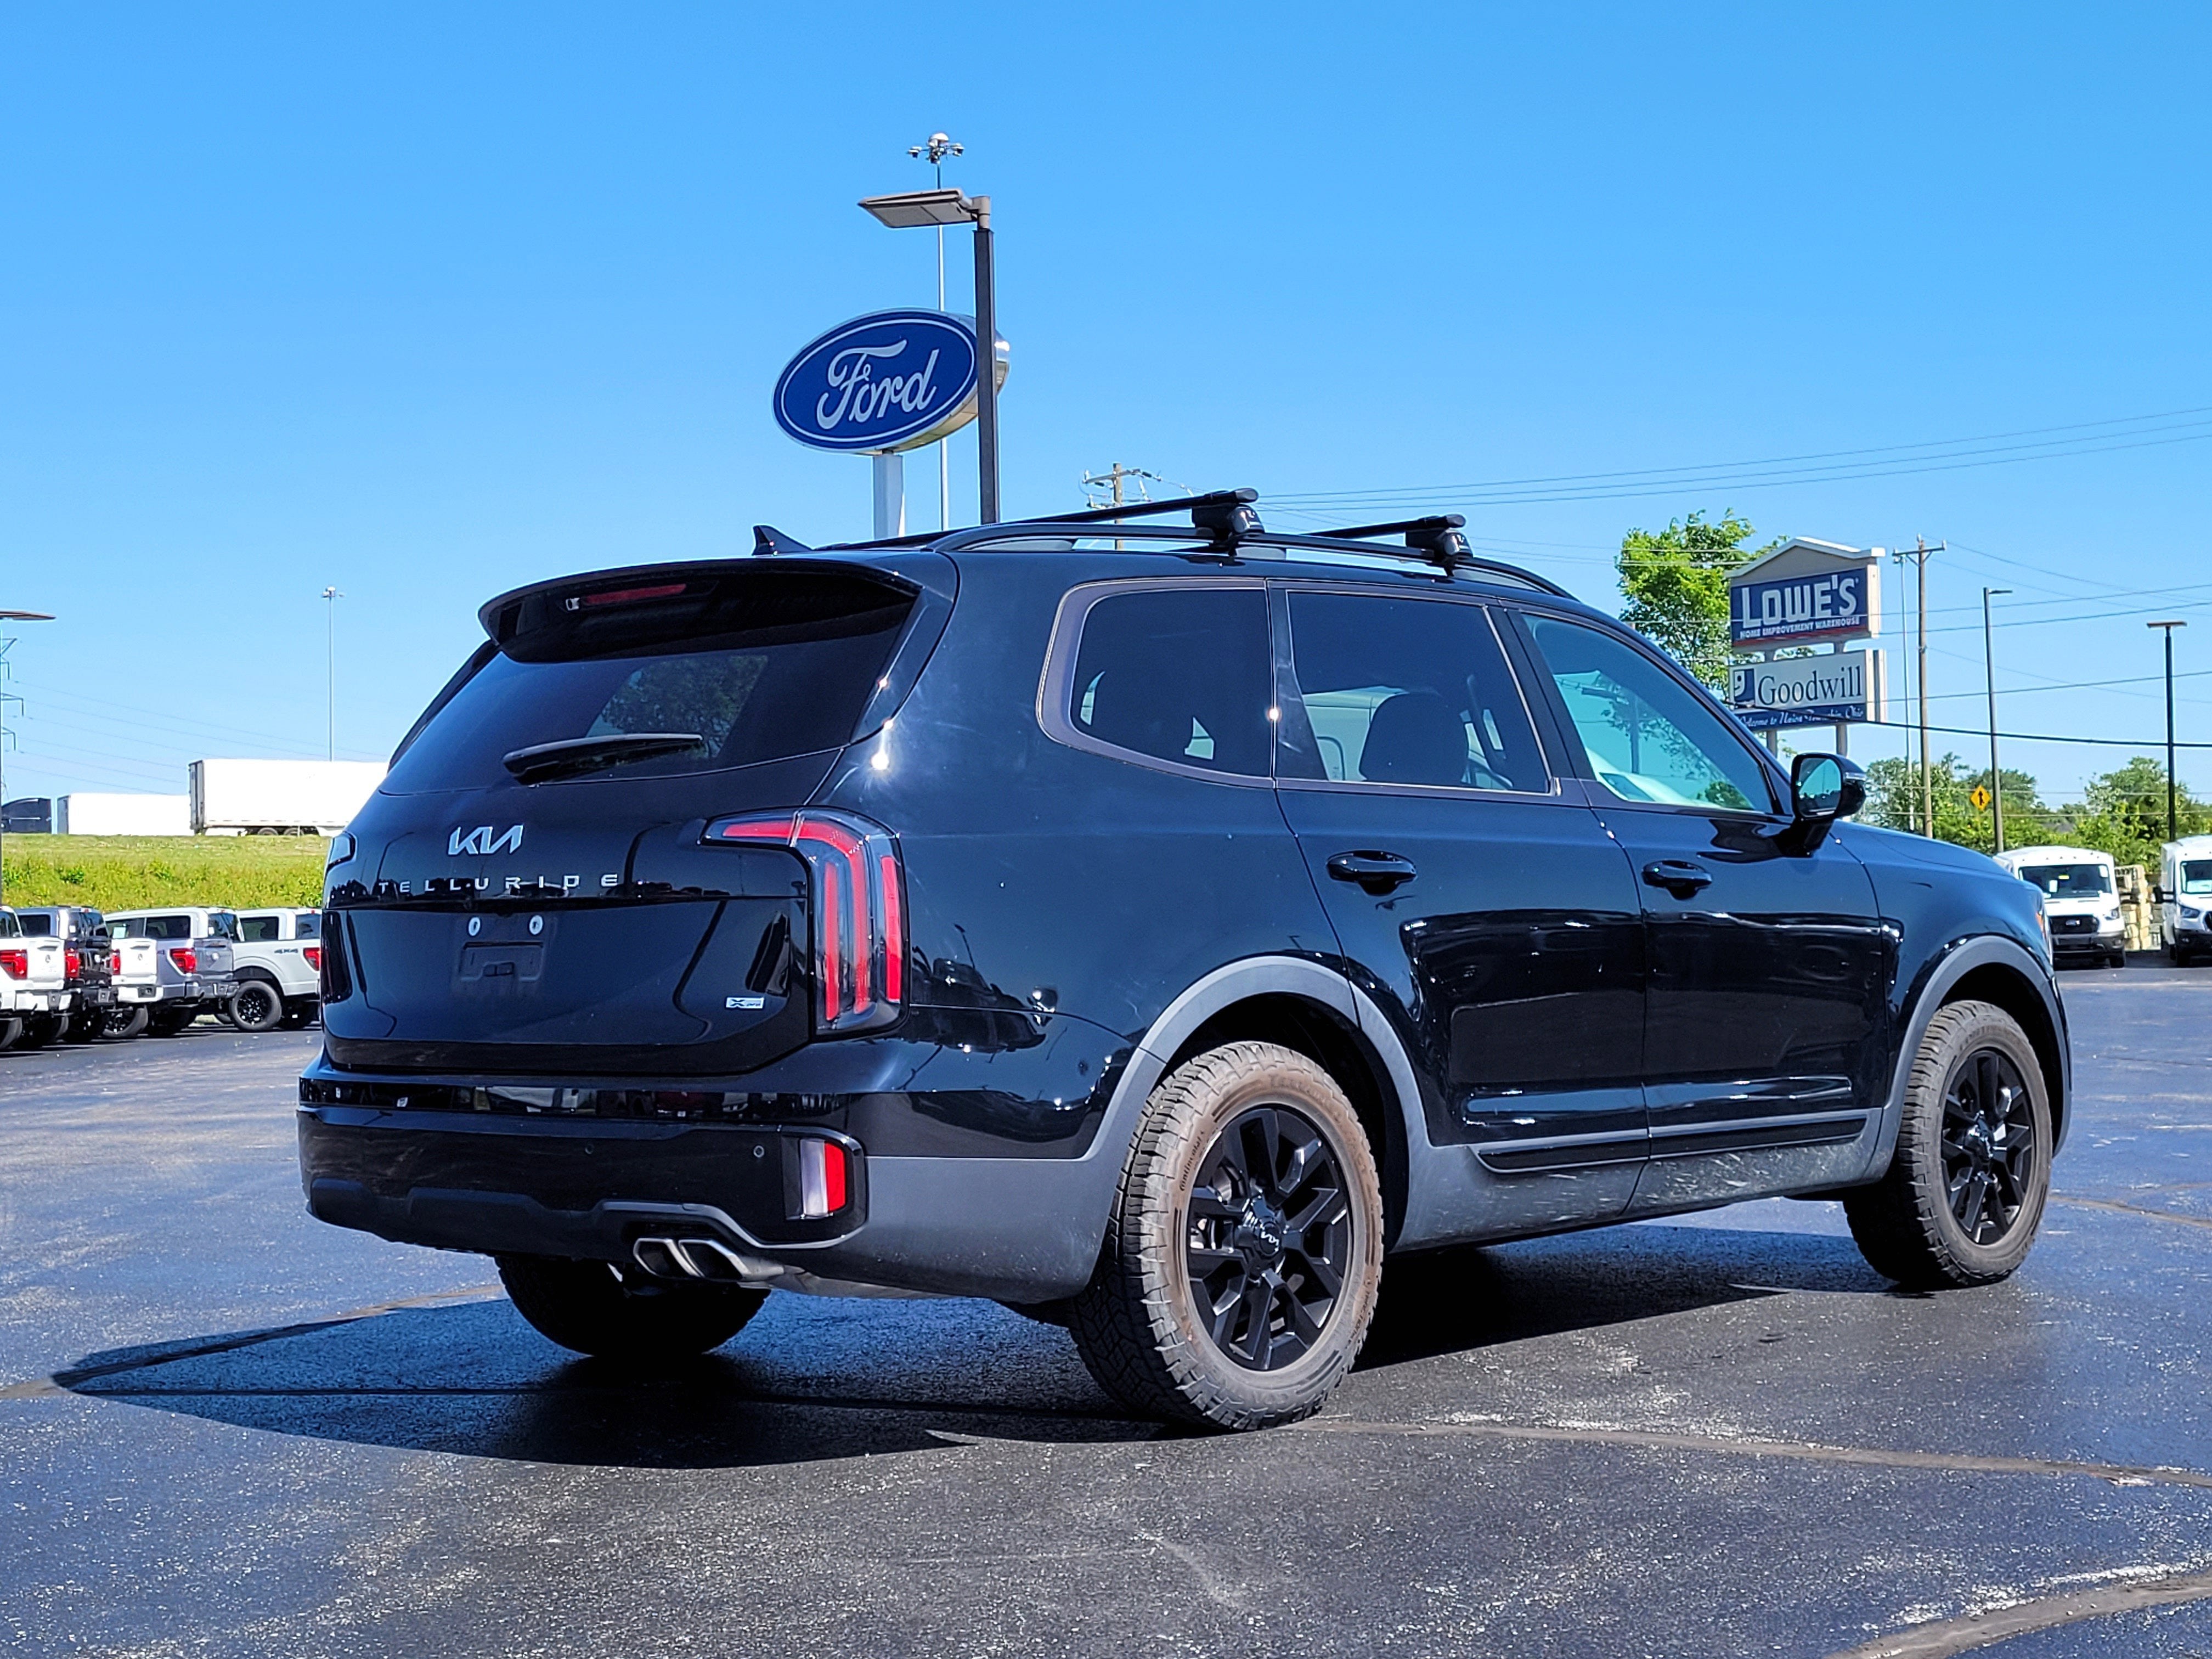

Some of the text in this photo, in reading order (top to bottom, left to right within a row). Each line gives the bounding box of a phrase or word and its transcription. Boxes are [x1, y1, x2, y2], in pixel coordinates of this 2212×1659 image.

[816, 338, 940, 430] Ford
[1741, 574, 1857, 629] LOWE'S
[1739, 615, 1860, 640] HOME IMPROVEMENT WAREHOUSE
[1758, 665, 1862, 706] Goodwill
[1770, 716, 1778, 725] to
[447, 824, 524, 856] KIA
[378, 873, 619, 894] TELLURIDE
